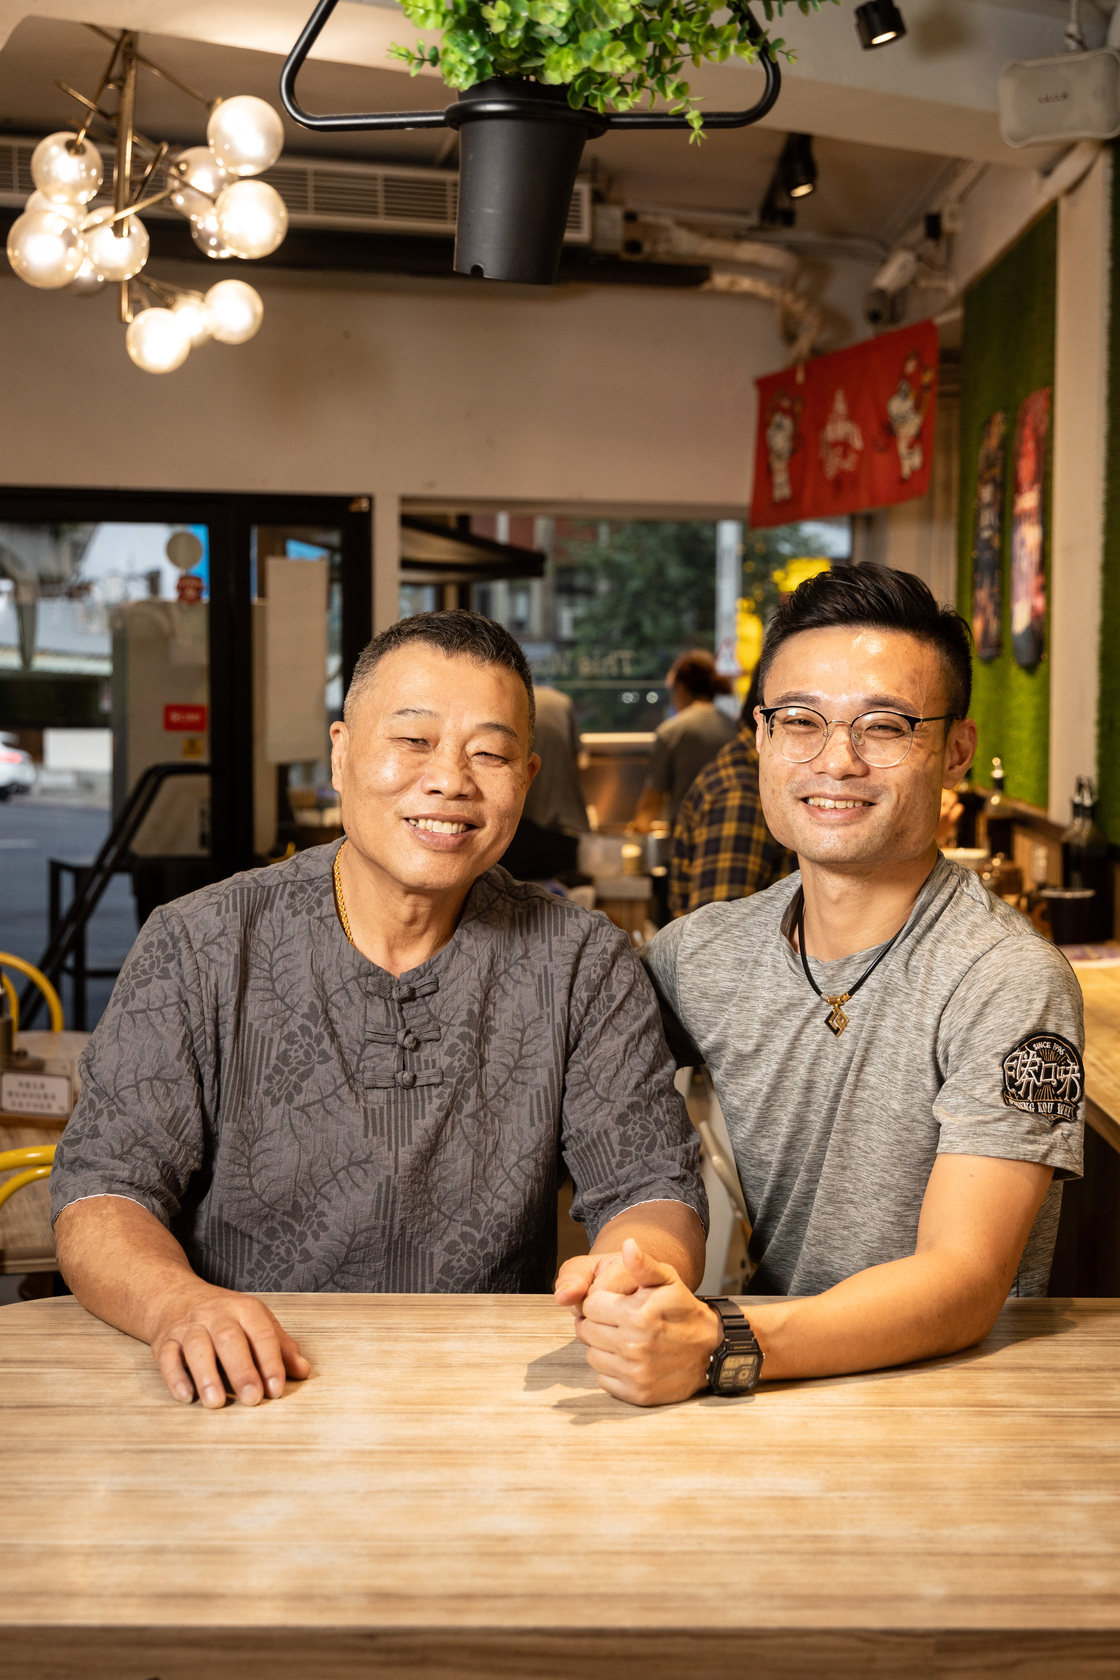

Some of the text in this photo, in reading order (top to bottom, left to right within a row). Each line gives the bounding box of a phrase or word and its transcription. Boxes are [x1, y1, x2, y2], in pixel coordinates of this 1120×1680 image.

[1033, 1041, 1066, 1055] SINCE 1996
[1037, 1102, 1054, 1114] KOU
